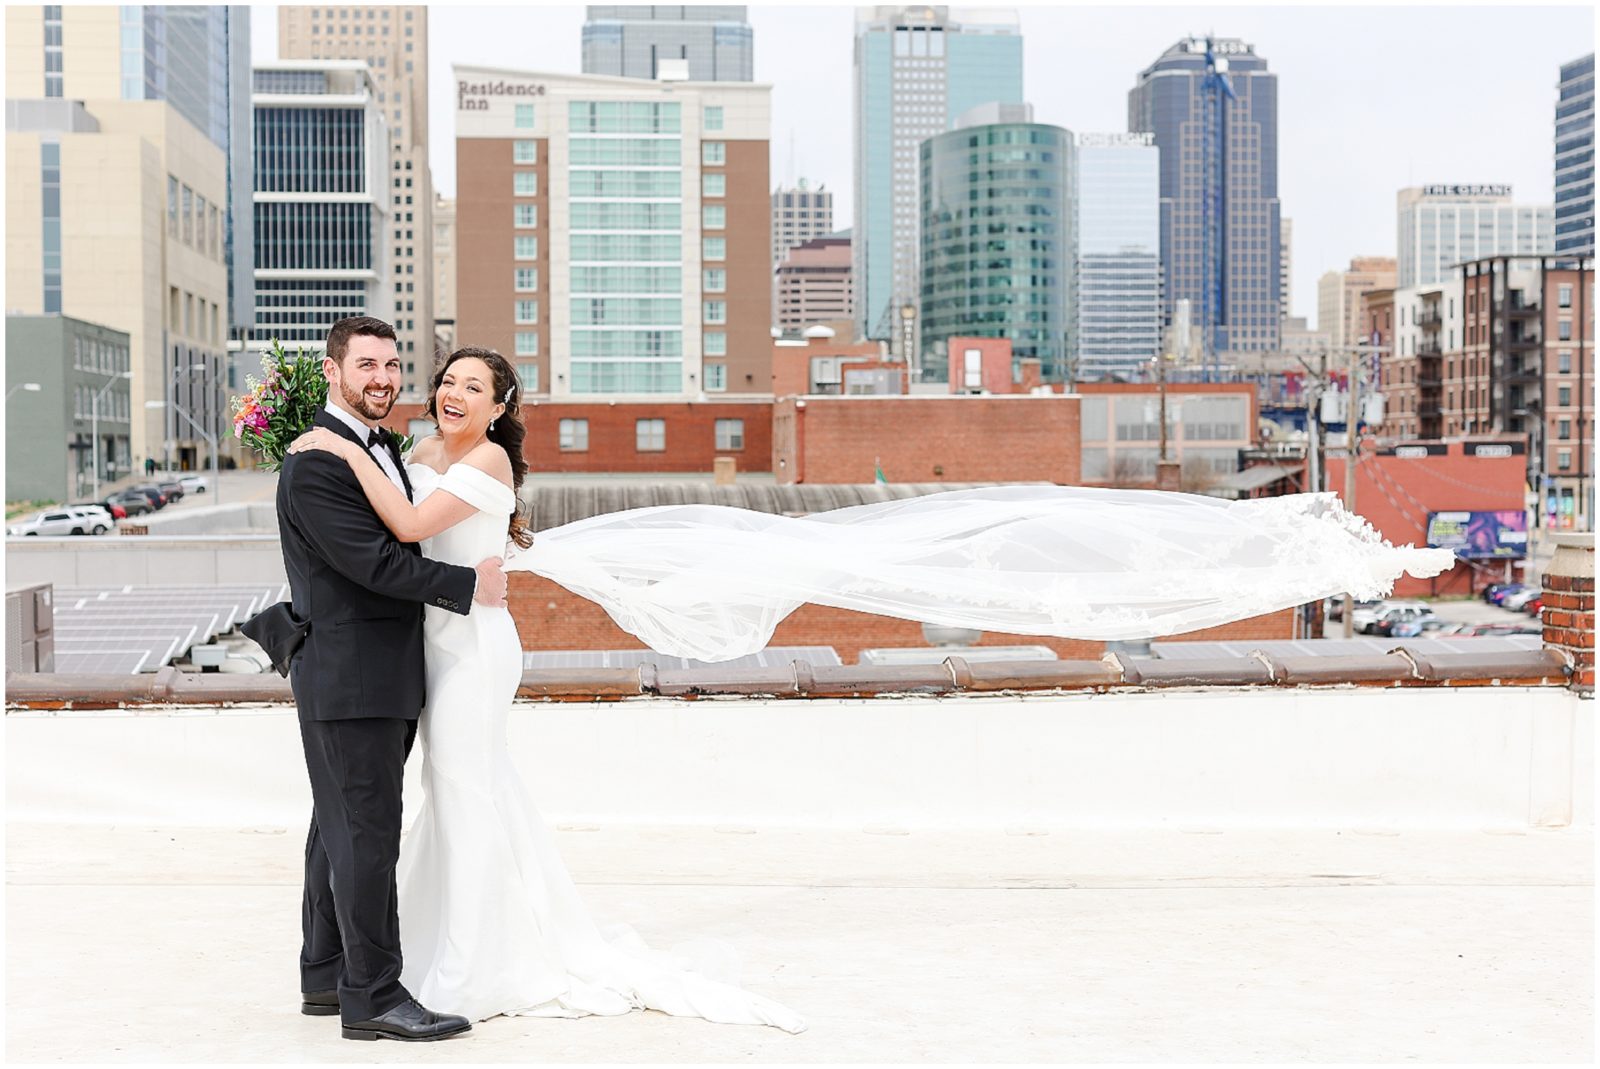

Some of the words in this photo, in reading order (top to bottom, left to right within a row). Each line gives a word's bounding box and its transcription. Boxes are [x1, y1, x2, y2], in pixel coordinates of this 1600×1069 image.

[458, 81, 546, 96] Residence
[458, 94, 490, 110] Inn
[1423, 184, 1454, 196] THE
[1457, 184, 1512, 196] GRAND
